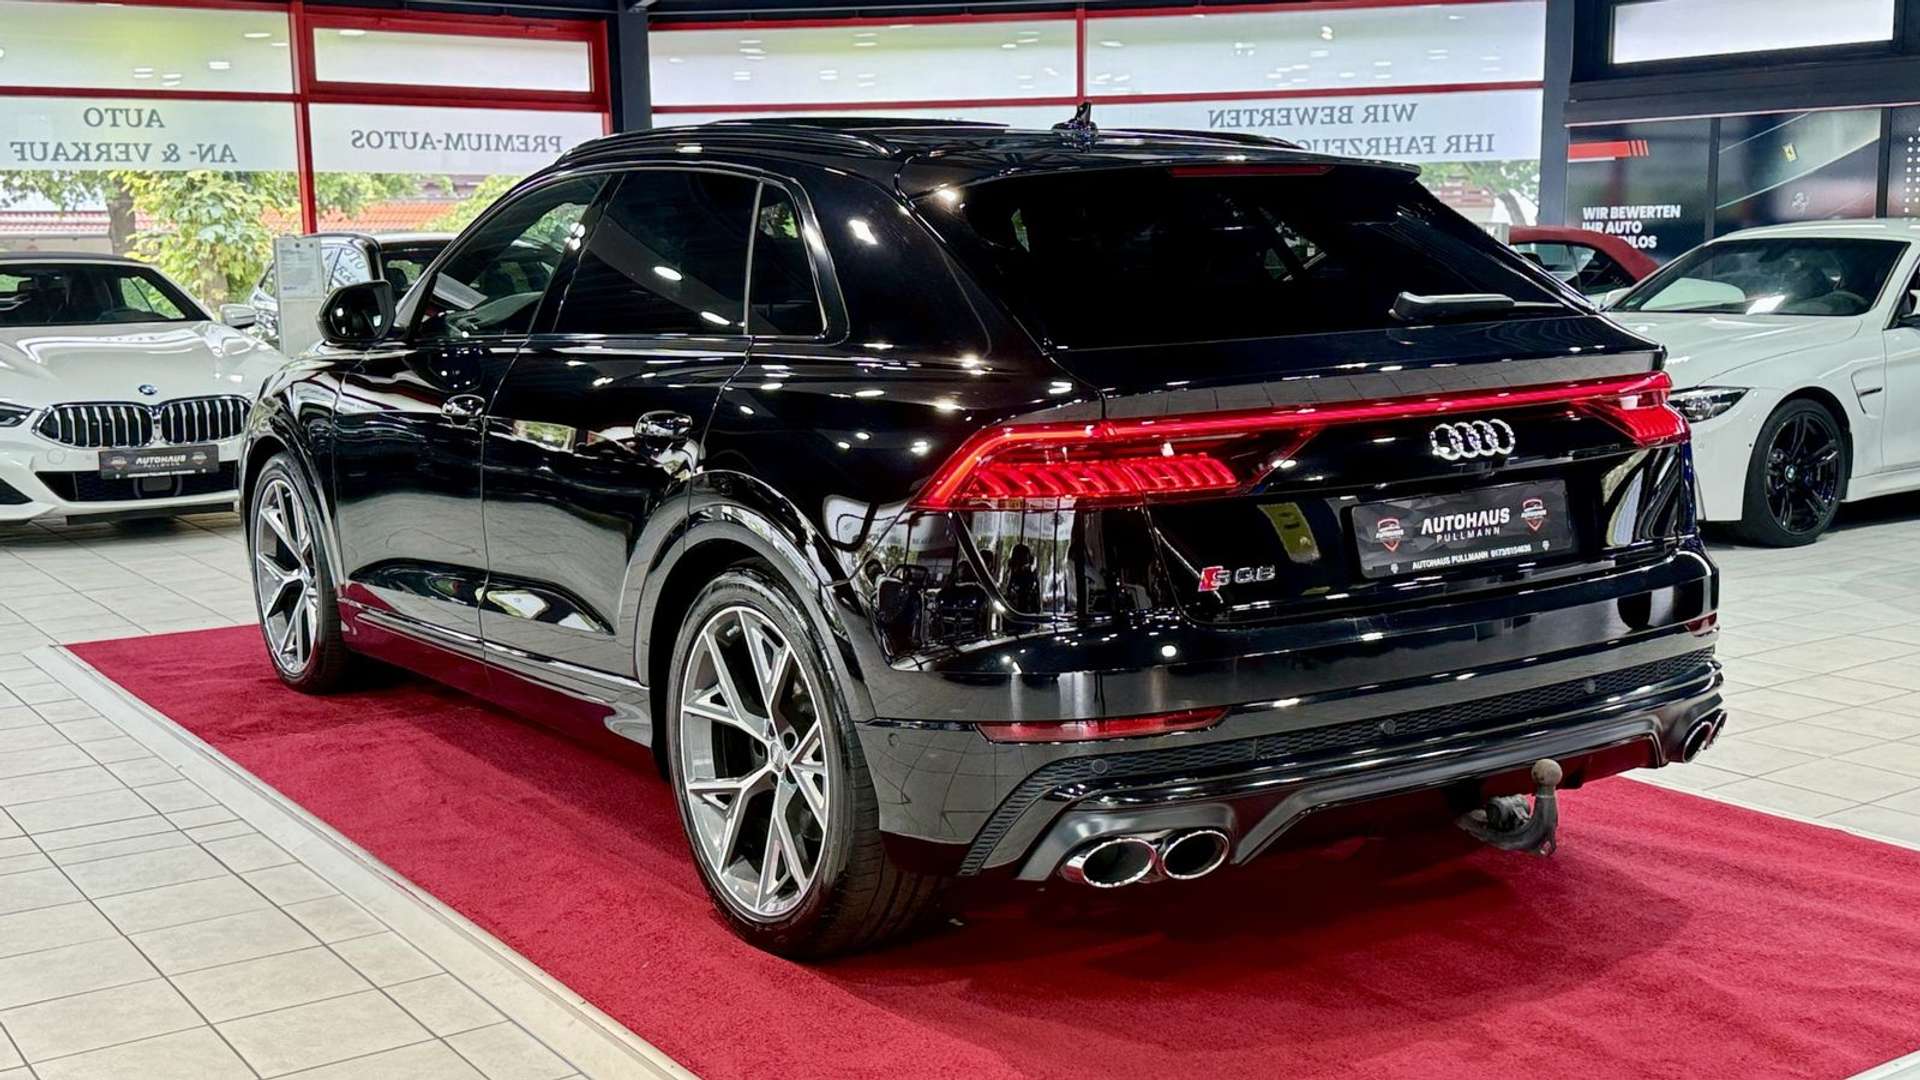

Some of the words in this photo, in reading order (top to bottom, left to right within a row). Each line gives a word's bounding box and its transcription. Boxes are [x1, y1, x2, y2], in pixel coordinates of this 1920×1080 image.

[1582, 206, 1609, 220] WIR
[1609, 205, 1682, 219] BEWERTEN
[1581, 221, 1604, 234] IHR
[1604, 220, 1643, 234] AUTO
[1420, 507, 1511, 535] AUTOHAUS
[1436, 526, 1501, 543] PULLMANN
[1412, 556, 1451, 570] AUTOHAUS
[1450, 550, 1489, 564] PULLMANN
